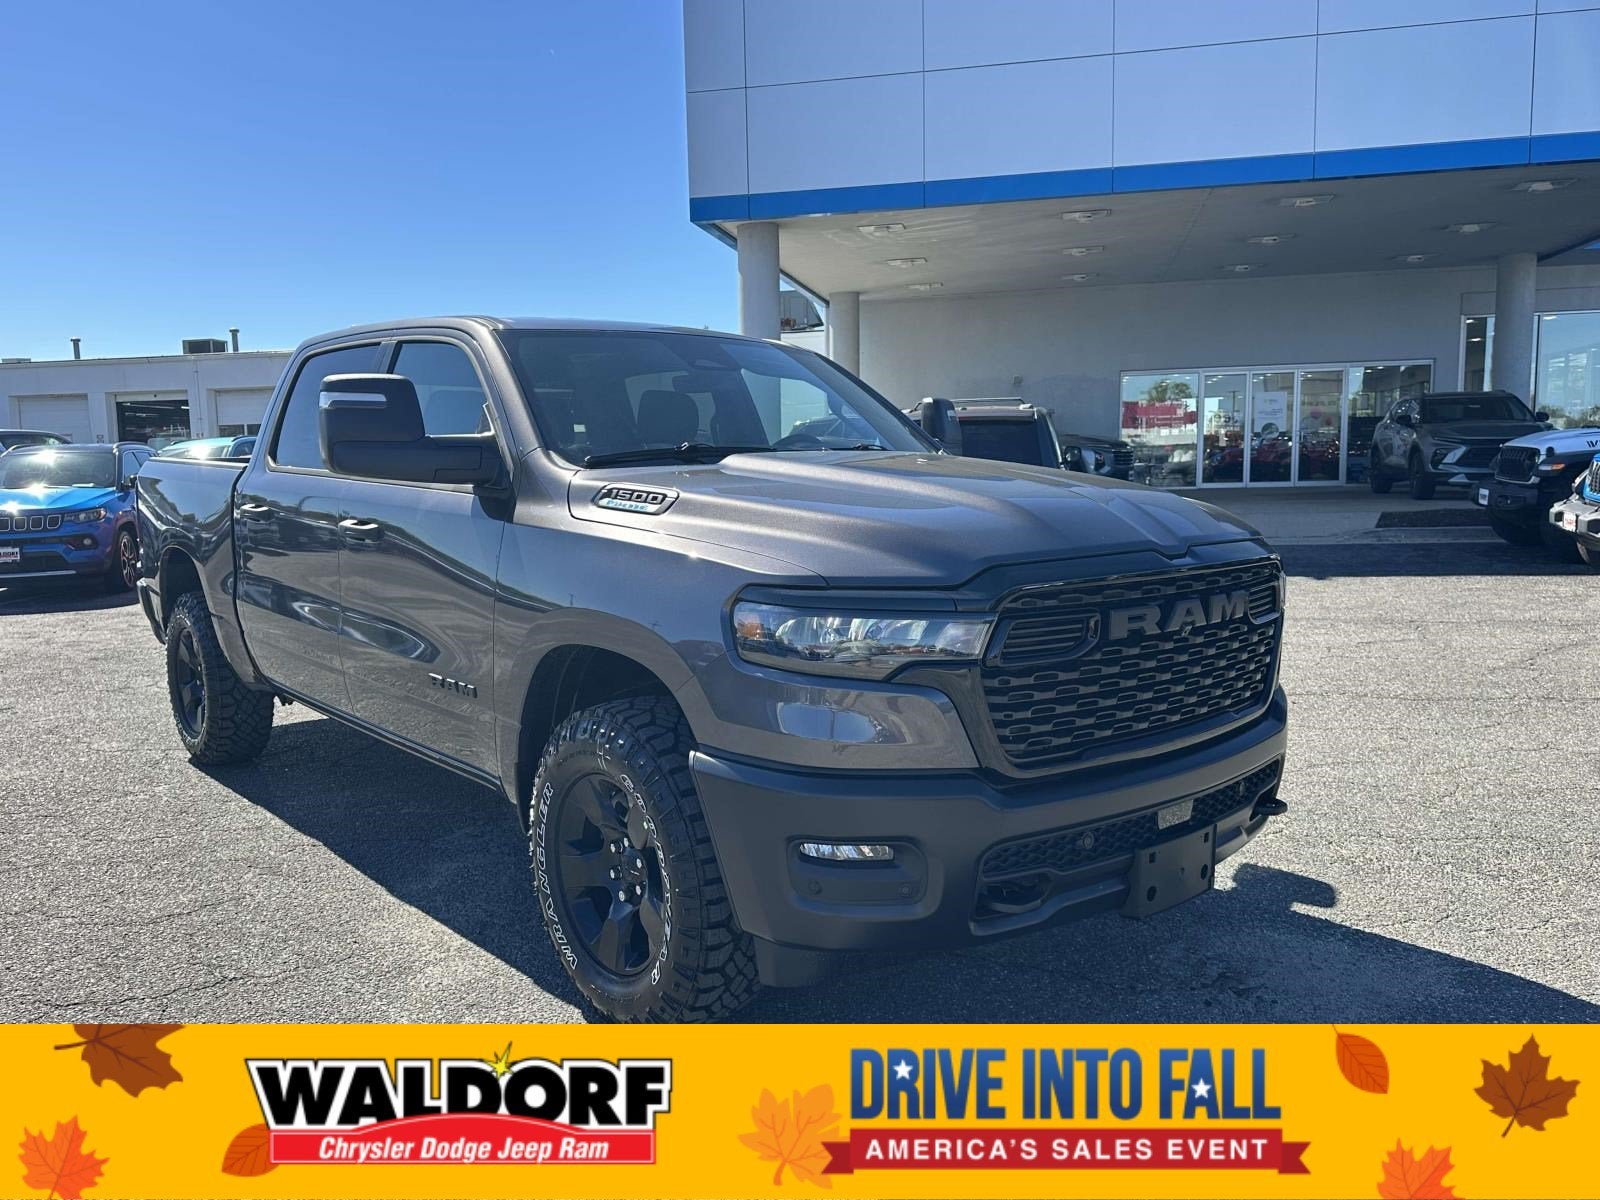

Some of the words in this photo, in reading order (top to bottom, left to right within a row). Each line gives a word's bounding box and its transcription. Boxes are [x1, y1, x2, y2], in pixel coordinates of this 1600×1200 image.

[610, 489, 664, 504] 1500
[1109, 589, 1250, 640] RAM
[536, 782, 578, 971] WRANGLER
[619, 774, 672, 985] GOODYEAR
